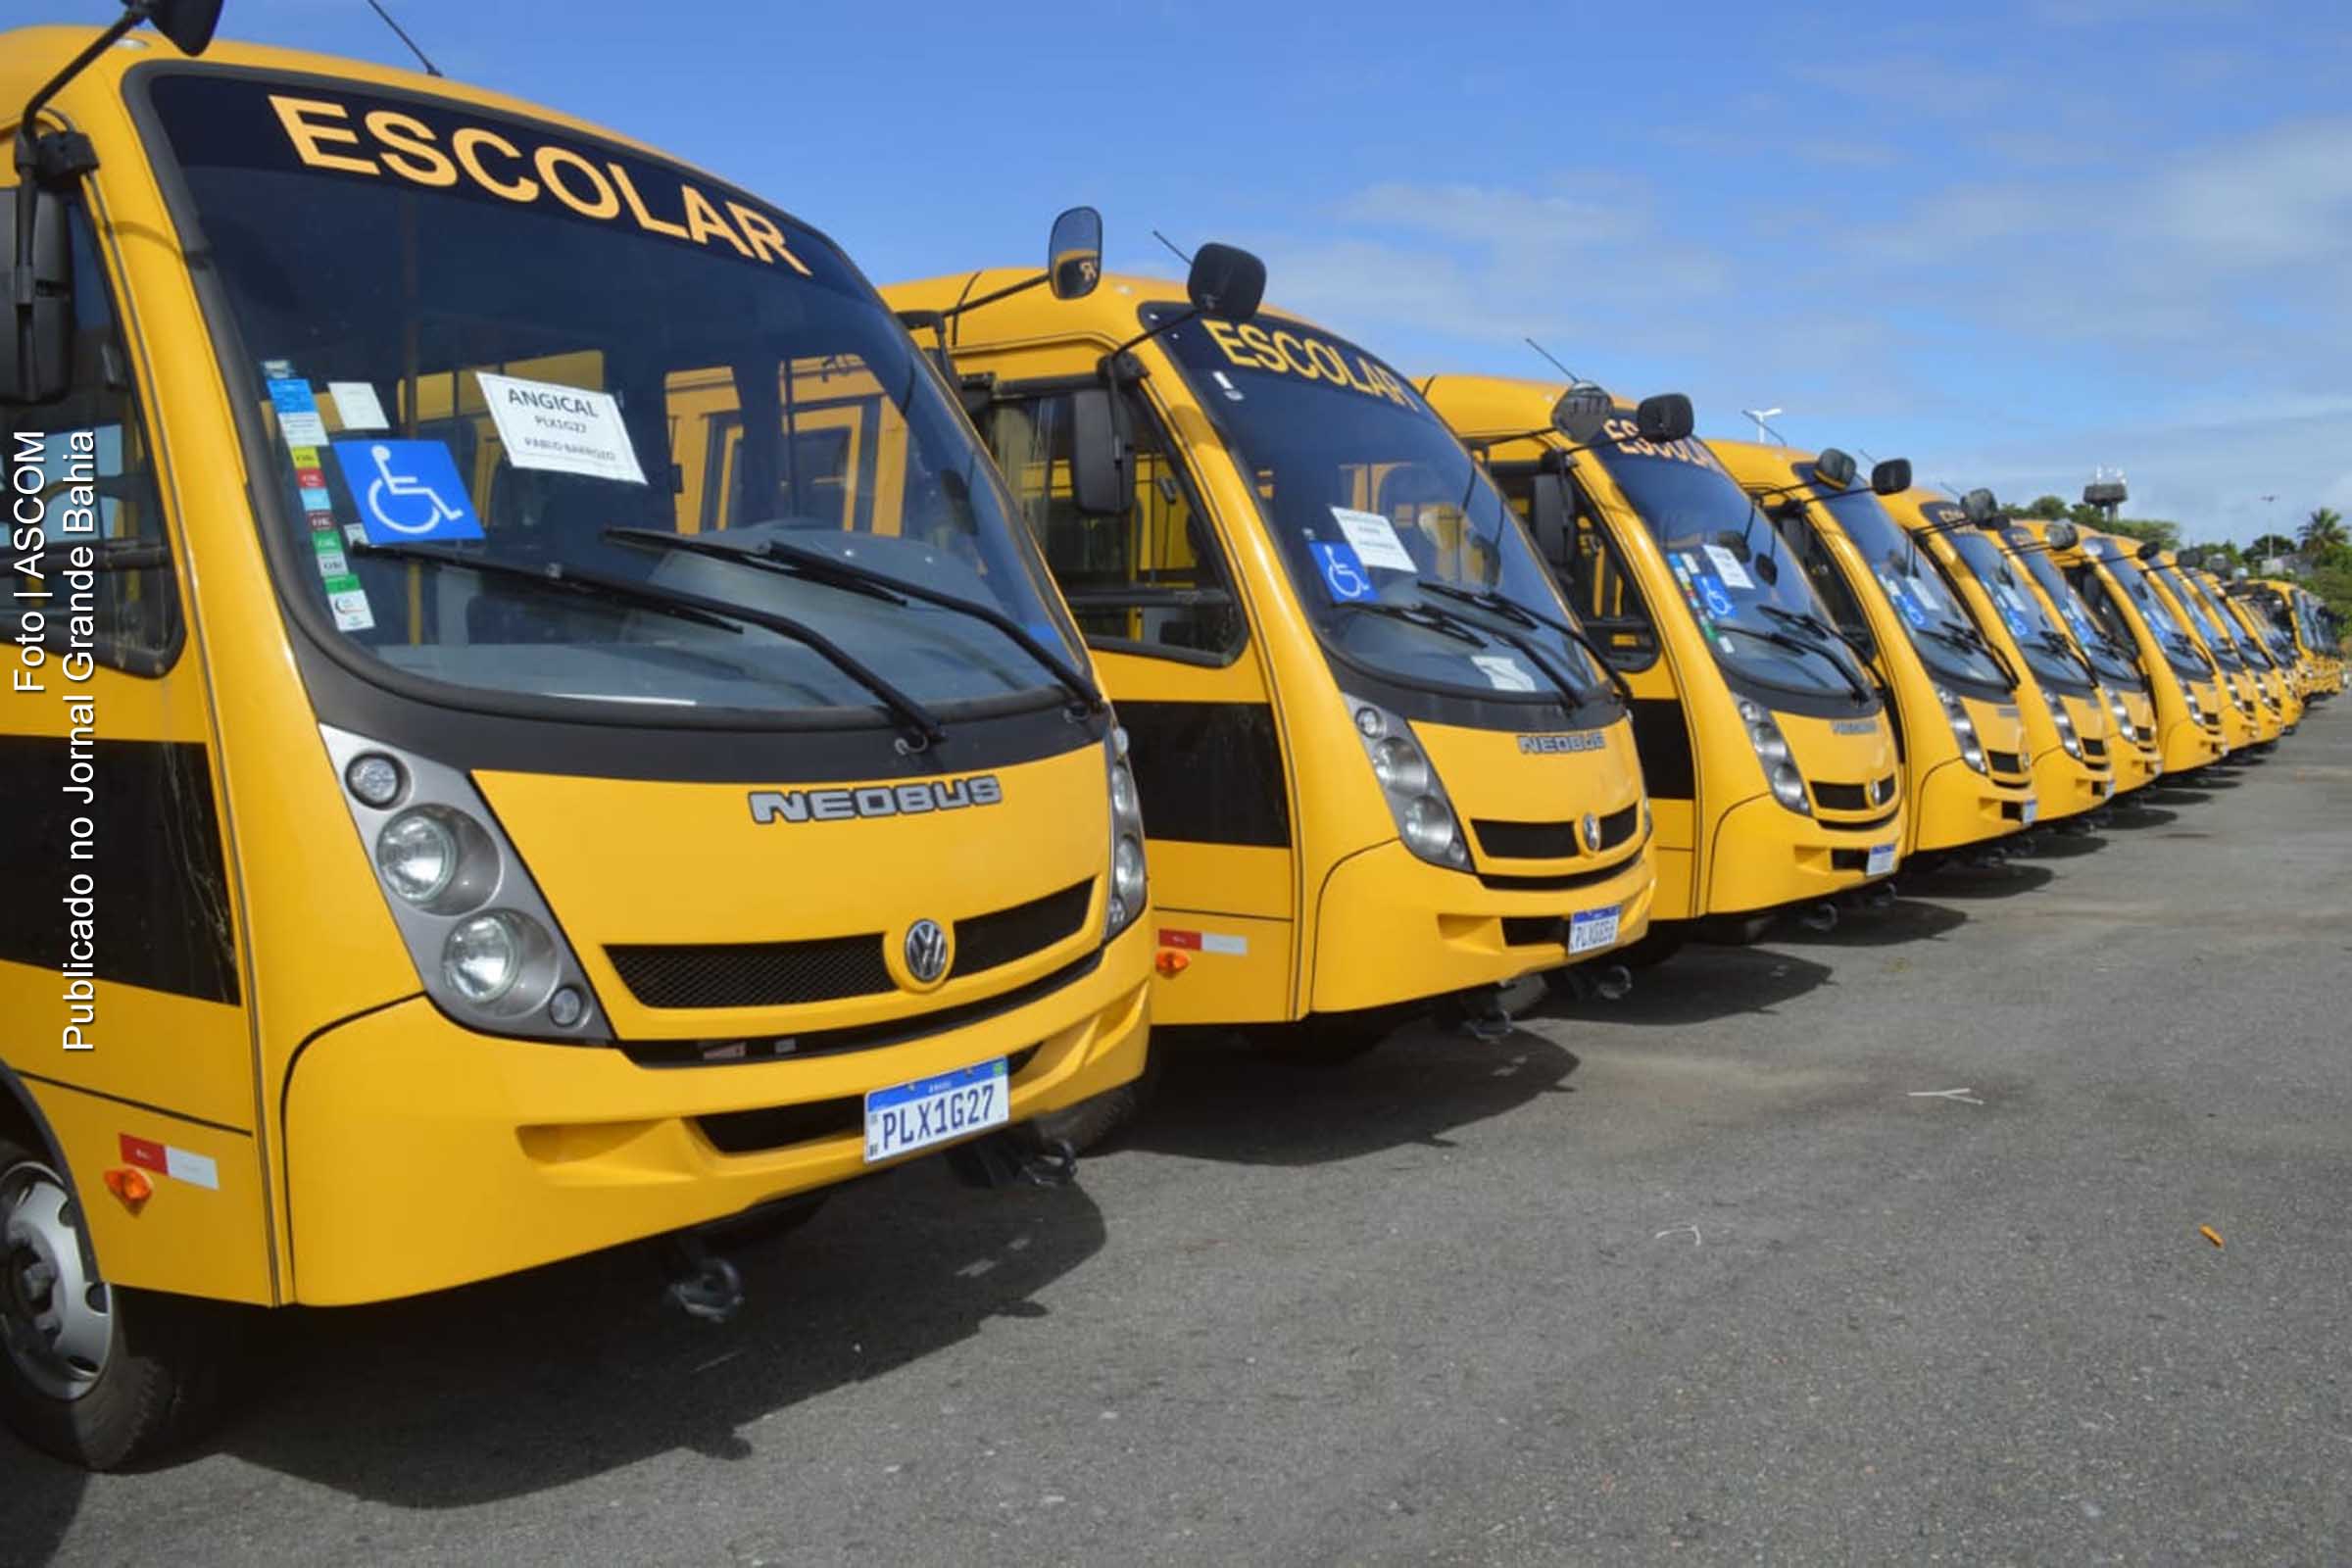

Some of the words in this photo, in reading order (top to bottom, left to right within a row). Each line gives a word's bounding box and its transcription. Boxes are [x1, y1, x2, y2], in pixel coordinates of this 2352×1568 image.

[269, 95, 811, 276] ESCOLAR
[1201, 318, 1419, 413] ESCOLAR
[508, 387, 599, 417] ANGICAL
[748, 774, 1002, 824] NEOBUS
[882, 1083, 995, 1151] PLX1G27
